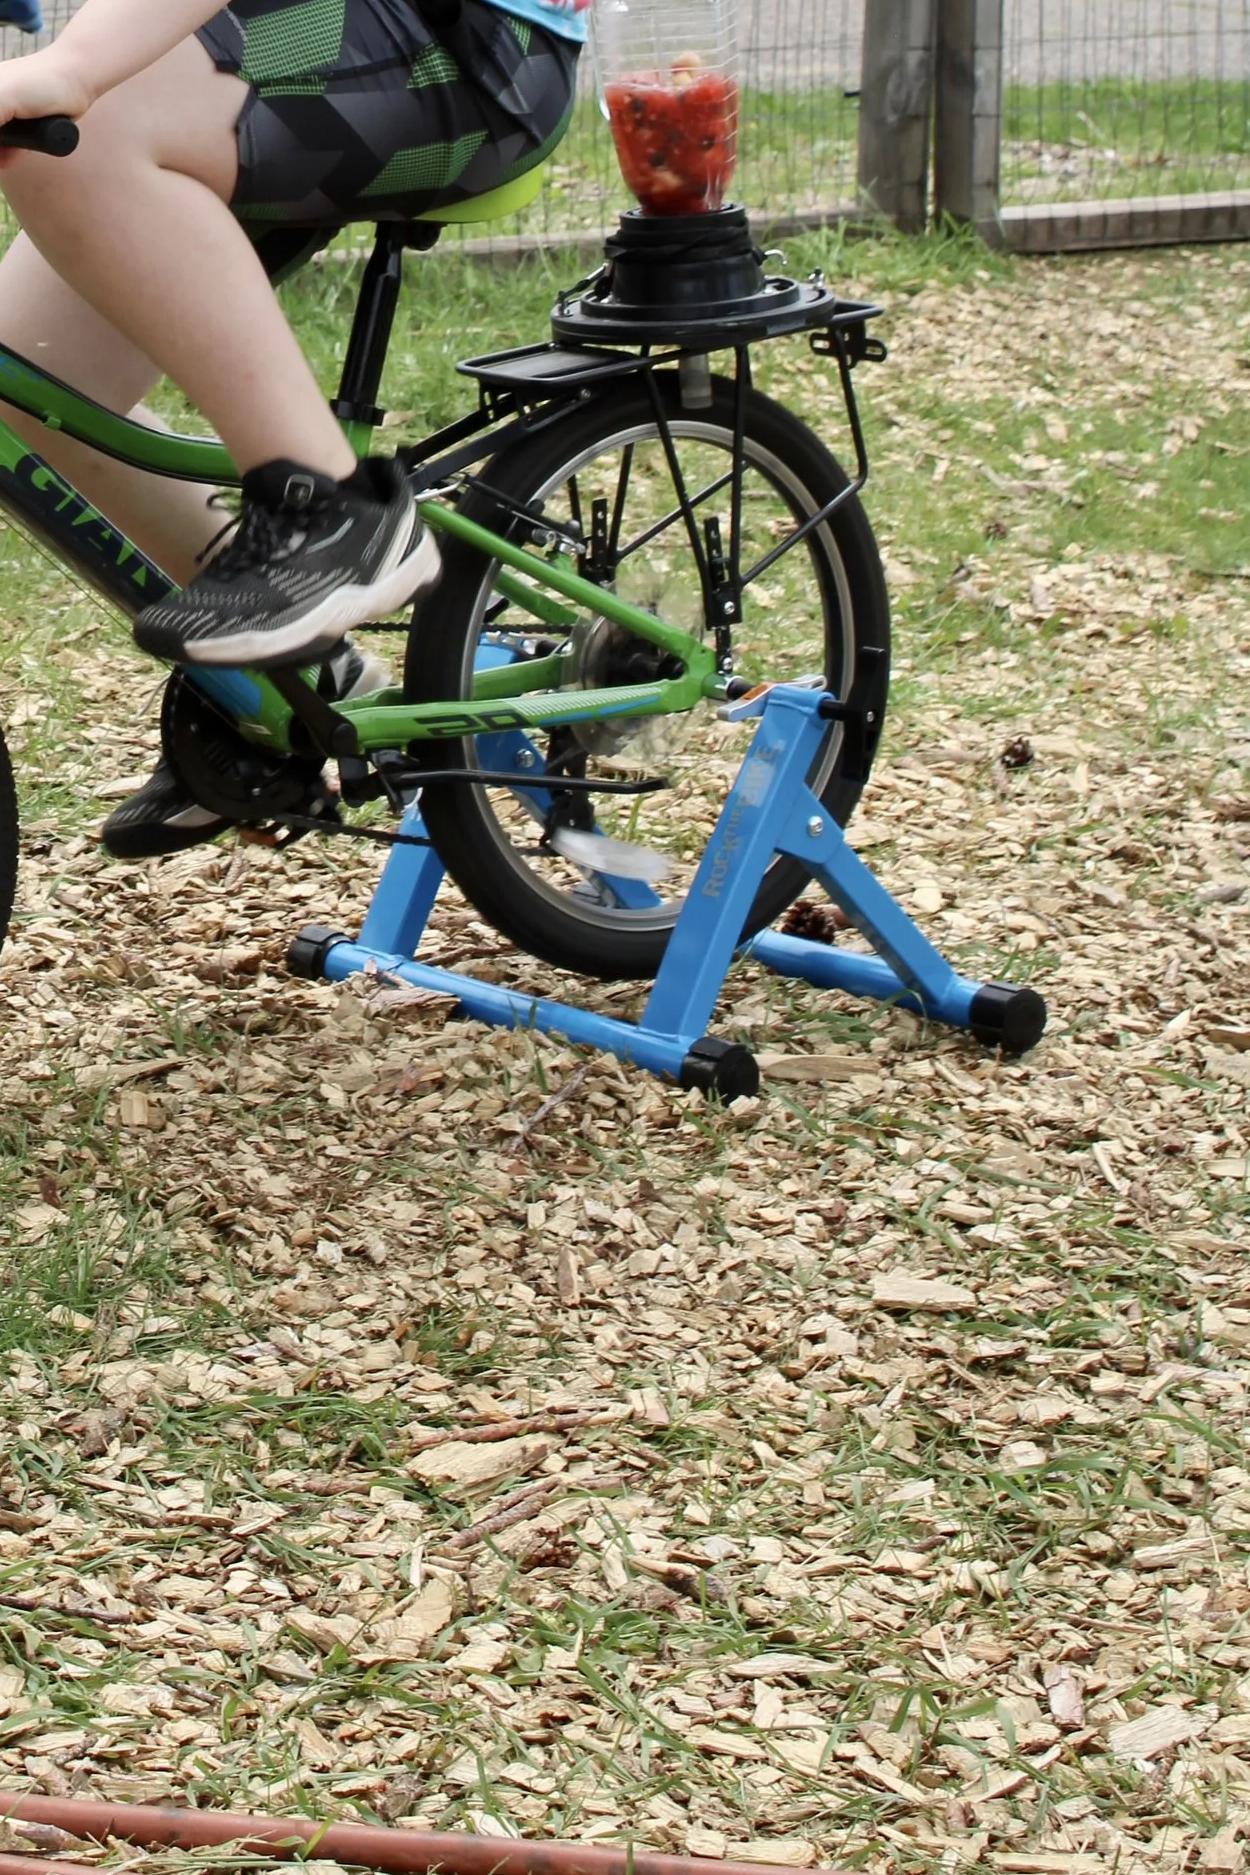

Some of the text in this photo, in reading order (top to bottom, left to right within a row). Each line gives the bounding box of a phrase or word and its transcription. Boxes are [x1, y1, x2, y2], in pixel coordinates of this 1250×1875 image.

[14, 452, 177, 606] GIAN
[413, 708, 534, 737] 20
[701, 832, 743, 898] ROCK
